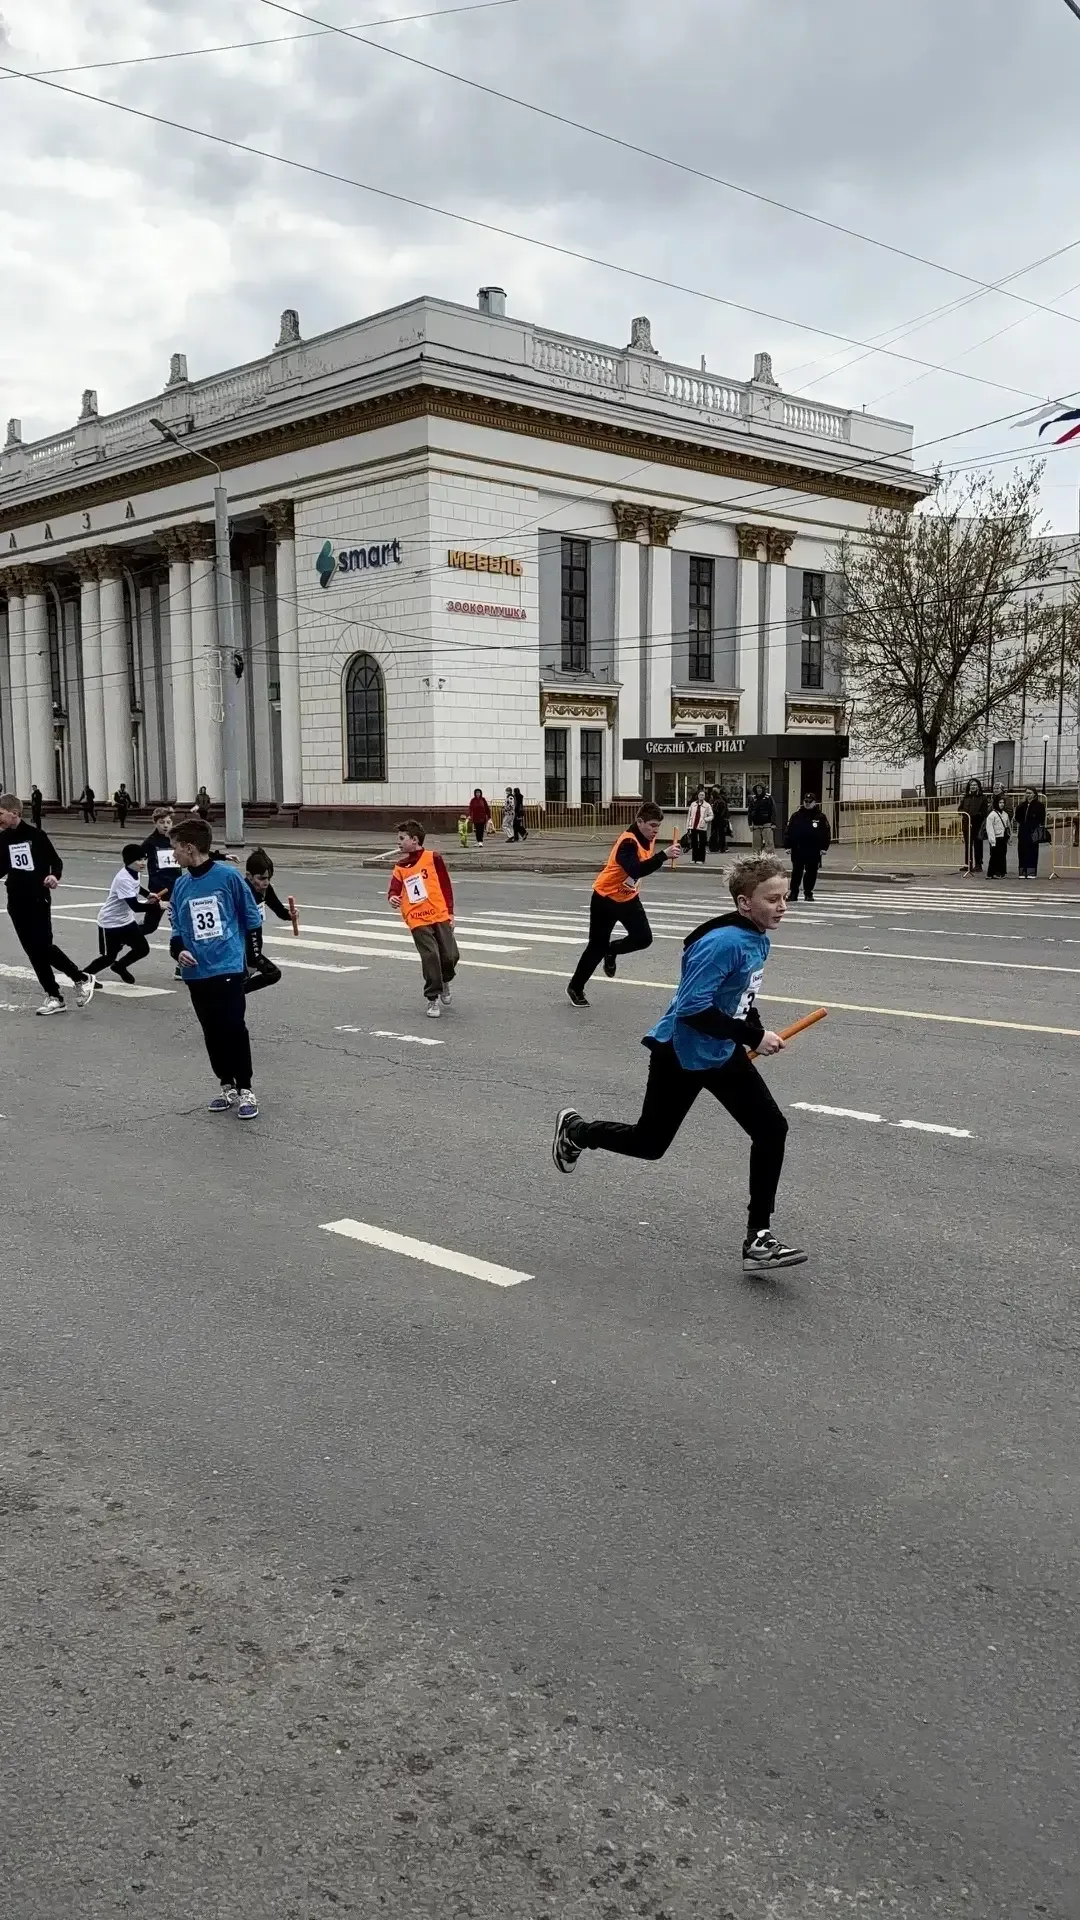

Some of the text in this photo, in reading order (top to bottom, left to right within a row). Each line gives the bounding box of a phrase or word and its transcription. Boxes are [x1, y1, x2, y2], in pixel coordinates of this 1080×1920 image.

[338, 537, 402, 573] smart
[447, 549, 523, 577] МЕБЕЛЬ
[446, 600, 527, 620] ЗООКОРМУШКА
[714, 739, 746, 752] РИАТ
[14, 853, 29, 867] 30
[421, 868, 429, 880] 3
[413, 884, 420, 896] 4
[410, 908, 436, 919] VIKING
[196, 911, 215, 931] 33
